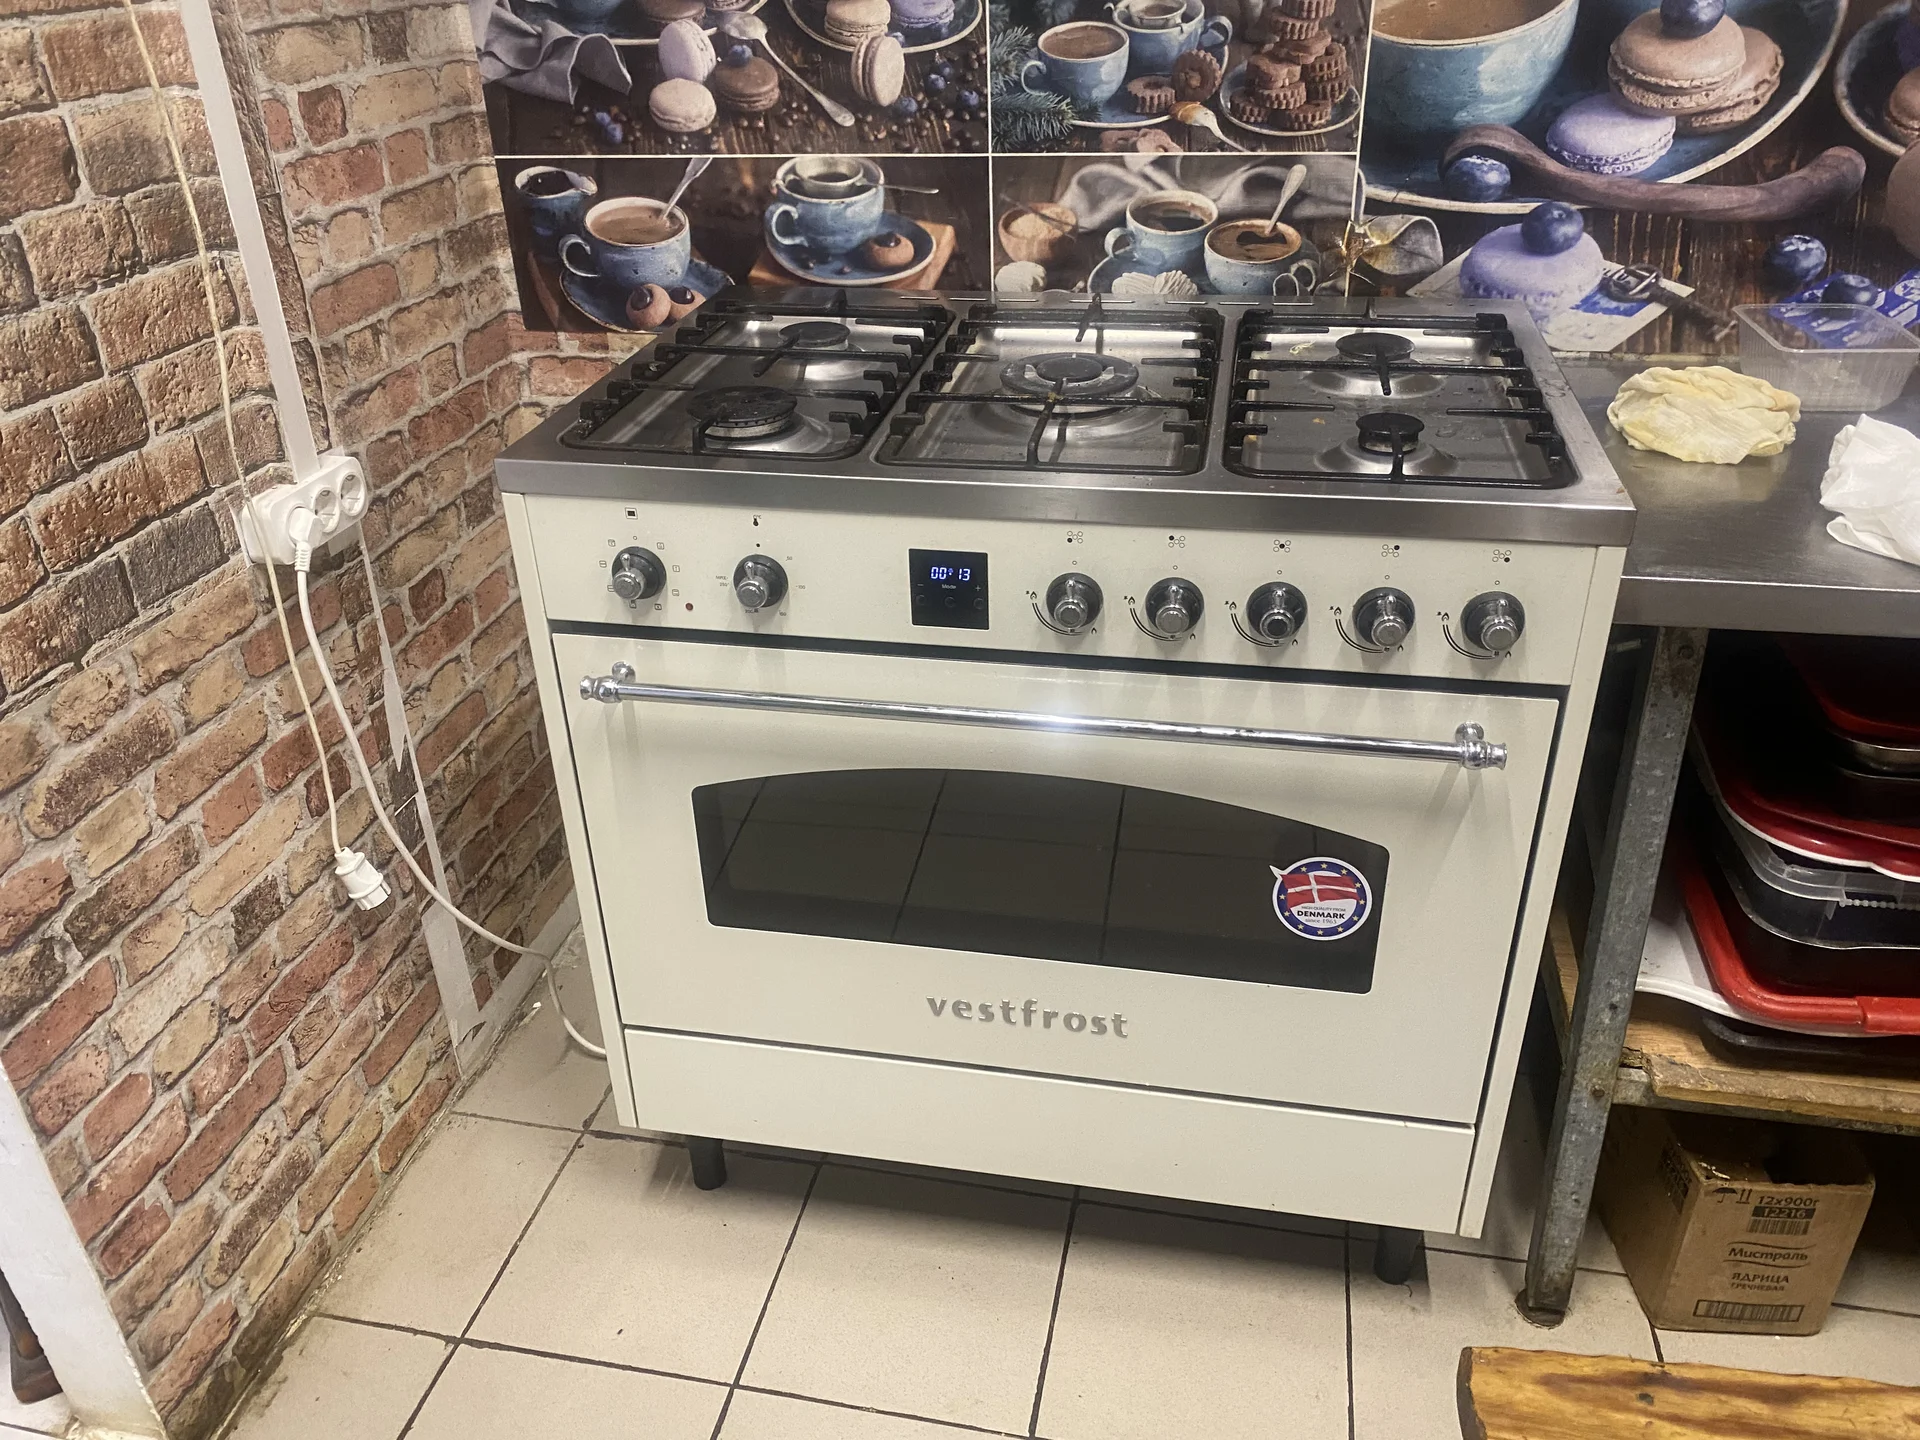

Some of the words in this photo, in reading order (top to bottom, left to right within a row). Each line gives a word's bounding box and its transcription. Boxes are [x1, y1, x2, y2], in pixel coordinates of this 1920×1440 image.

[1297, 910, 1346, 919] DENMARK
[926, 995, 1128, 1038] vestfrost
[1764, 1208, 1806, 1219] 12216
[1728, 1247, 1808, 1262] Мистраль
[1731, 1272, 1789, 1283] ЯДРИЦА
[1731, 1283, 1785, 1291] ГРЕЧНЕВАЯ
